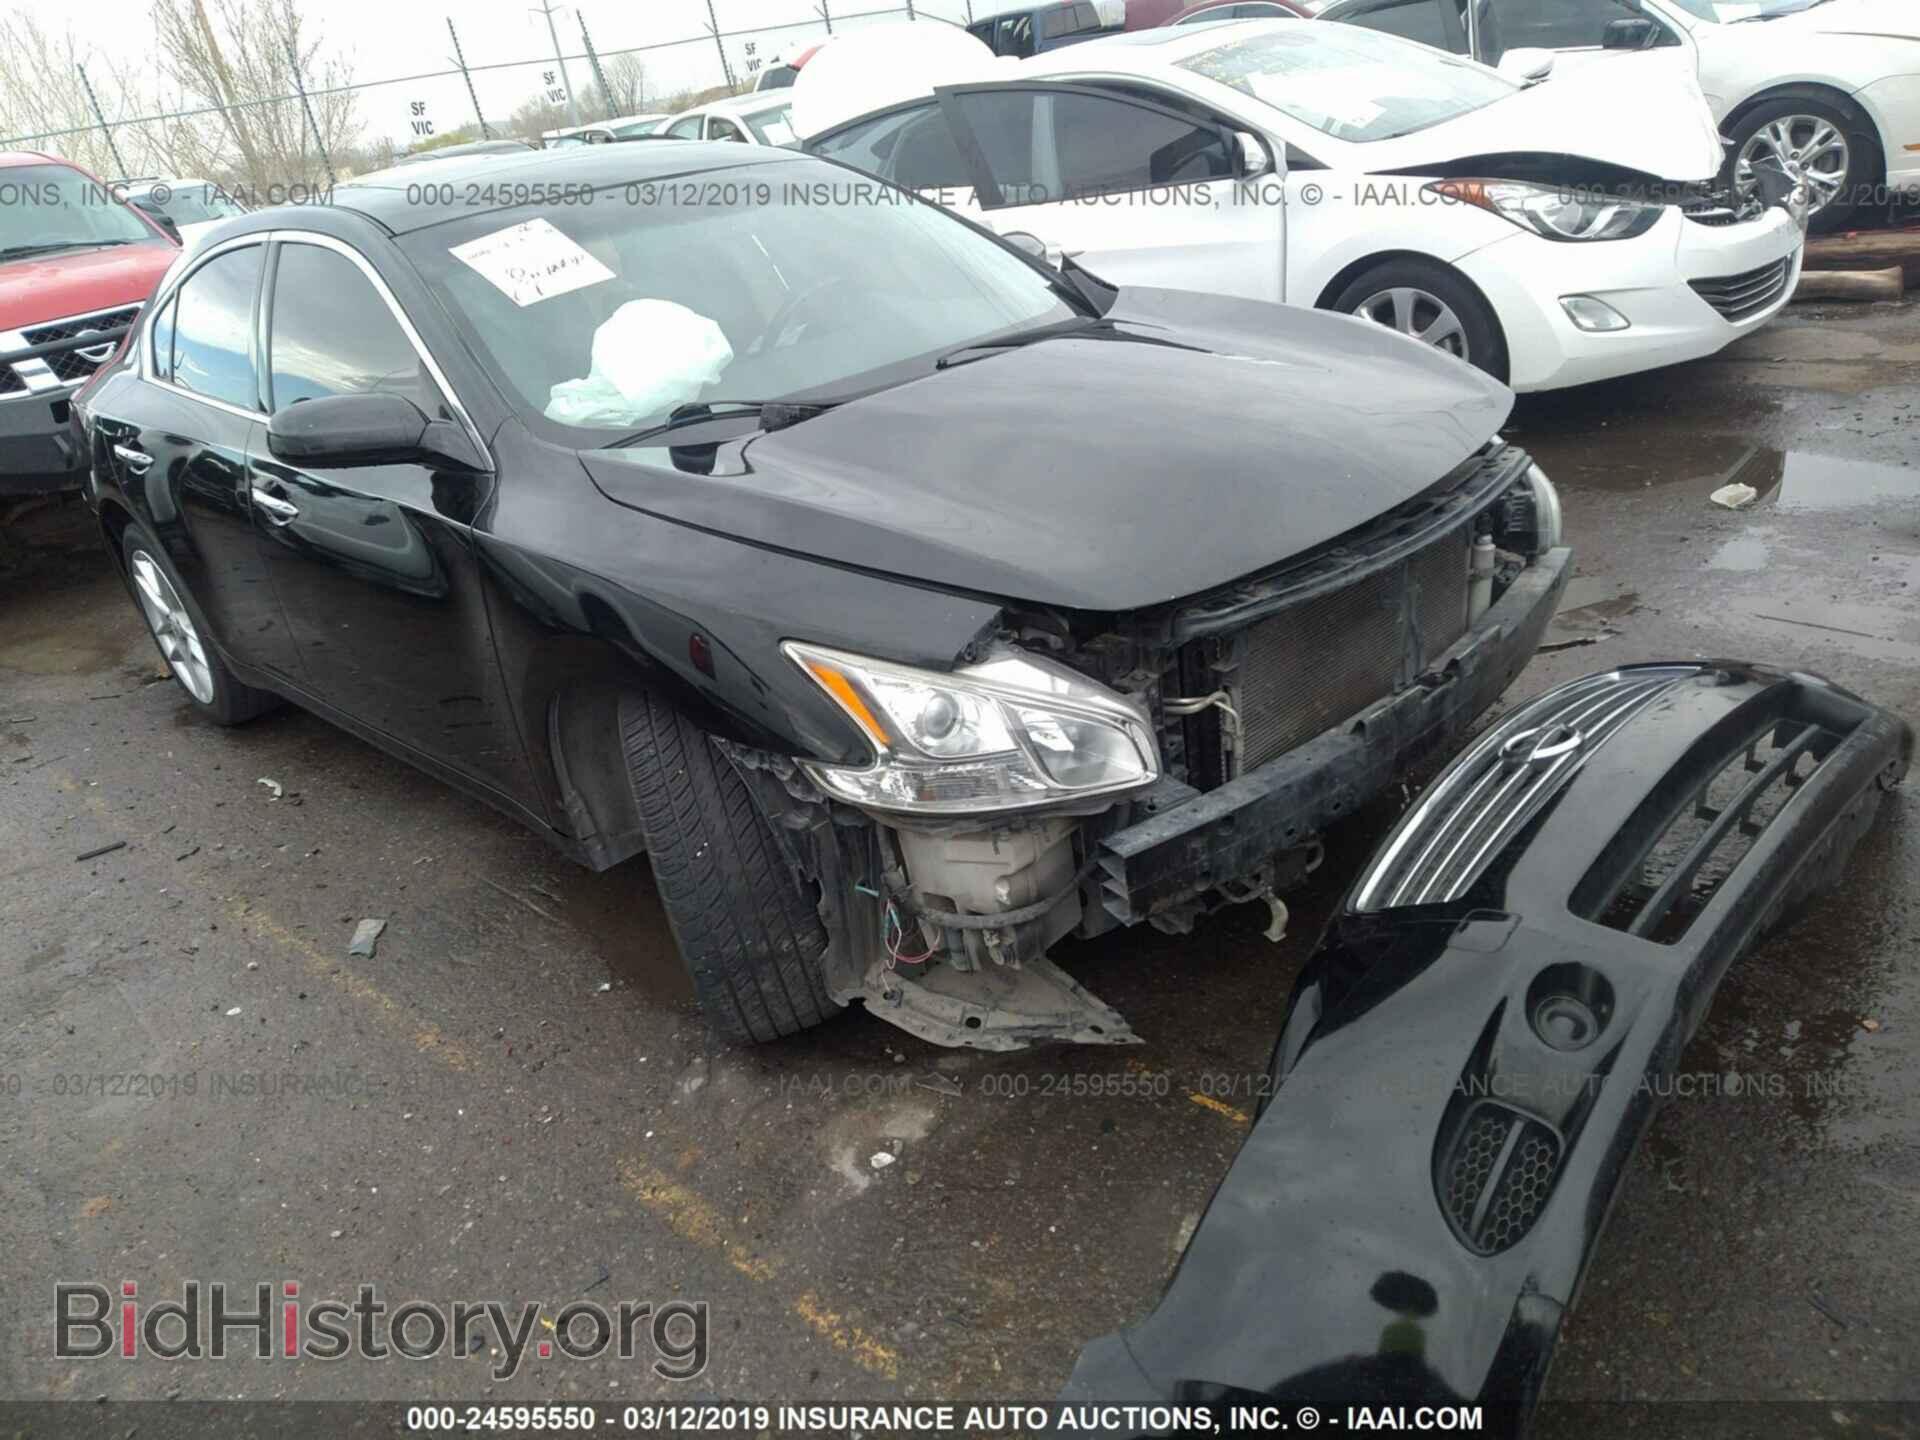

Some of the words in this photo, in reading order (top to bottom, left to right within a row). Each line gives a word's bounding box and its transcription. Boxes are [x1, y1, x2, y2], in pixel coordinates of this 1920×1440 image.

[543, 71, 556, 86] SF
[546, 88, 567, 103] VIC
[410, 101, 426, 117] SF
[410, 120, 435, 136] VIC
